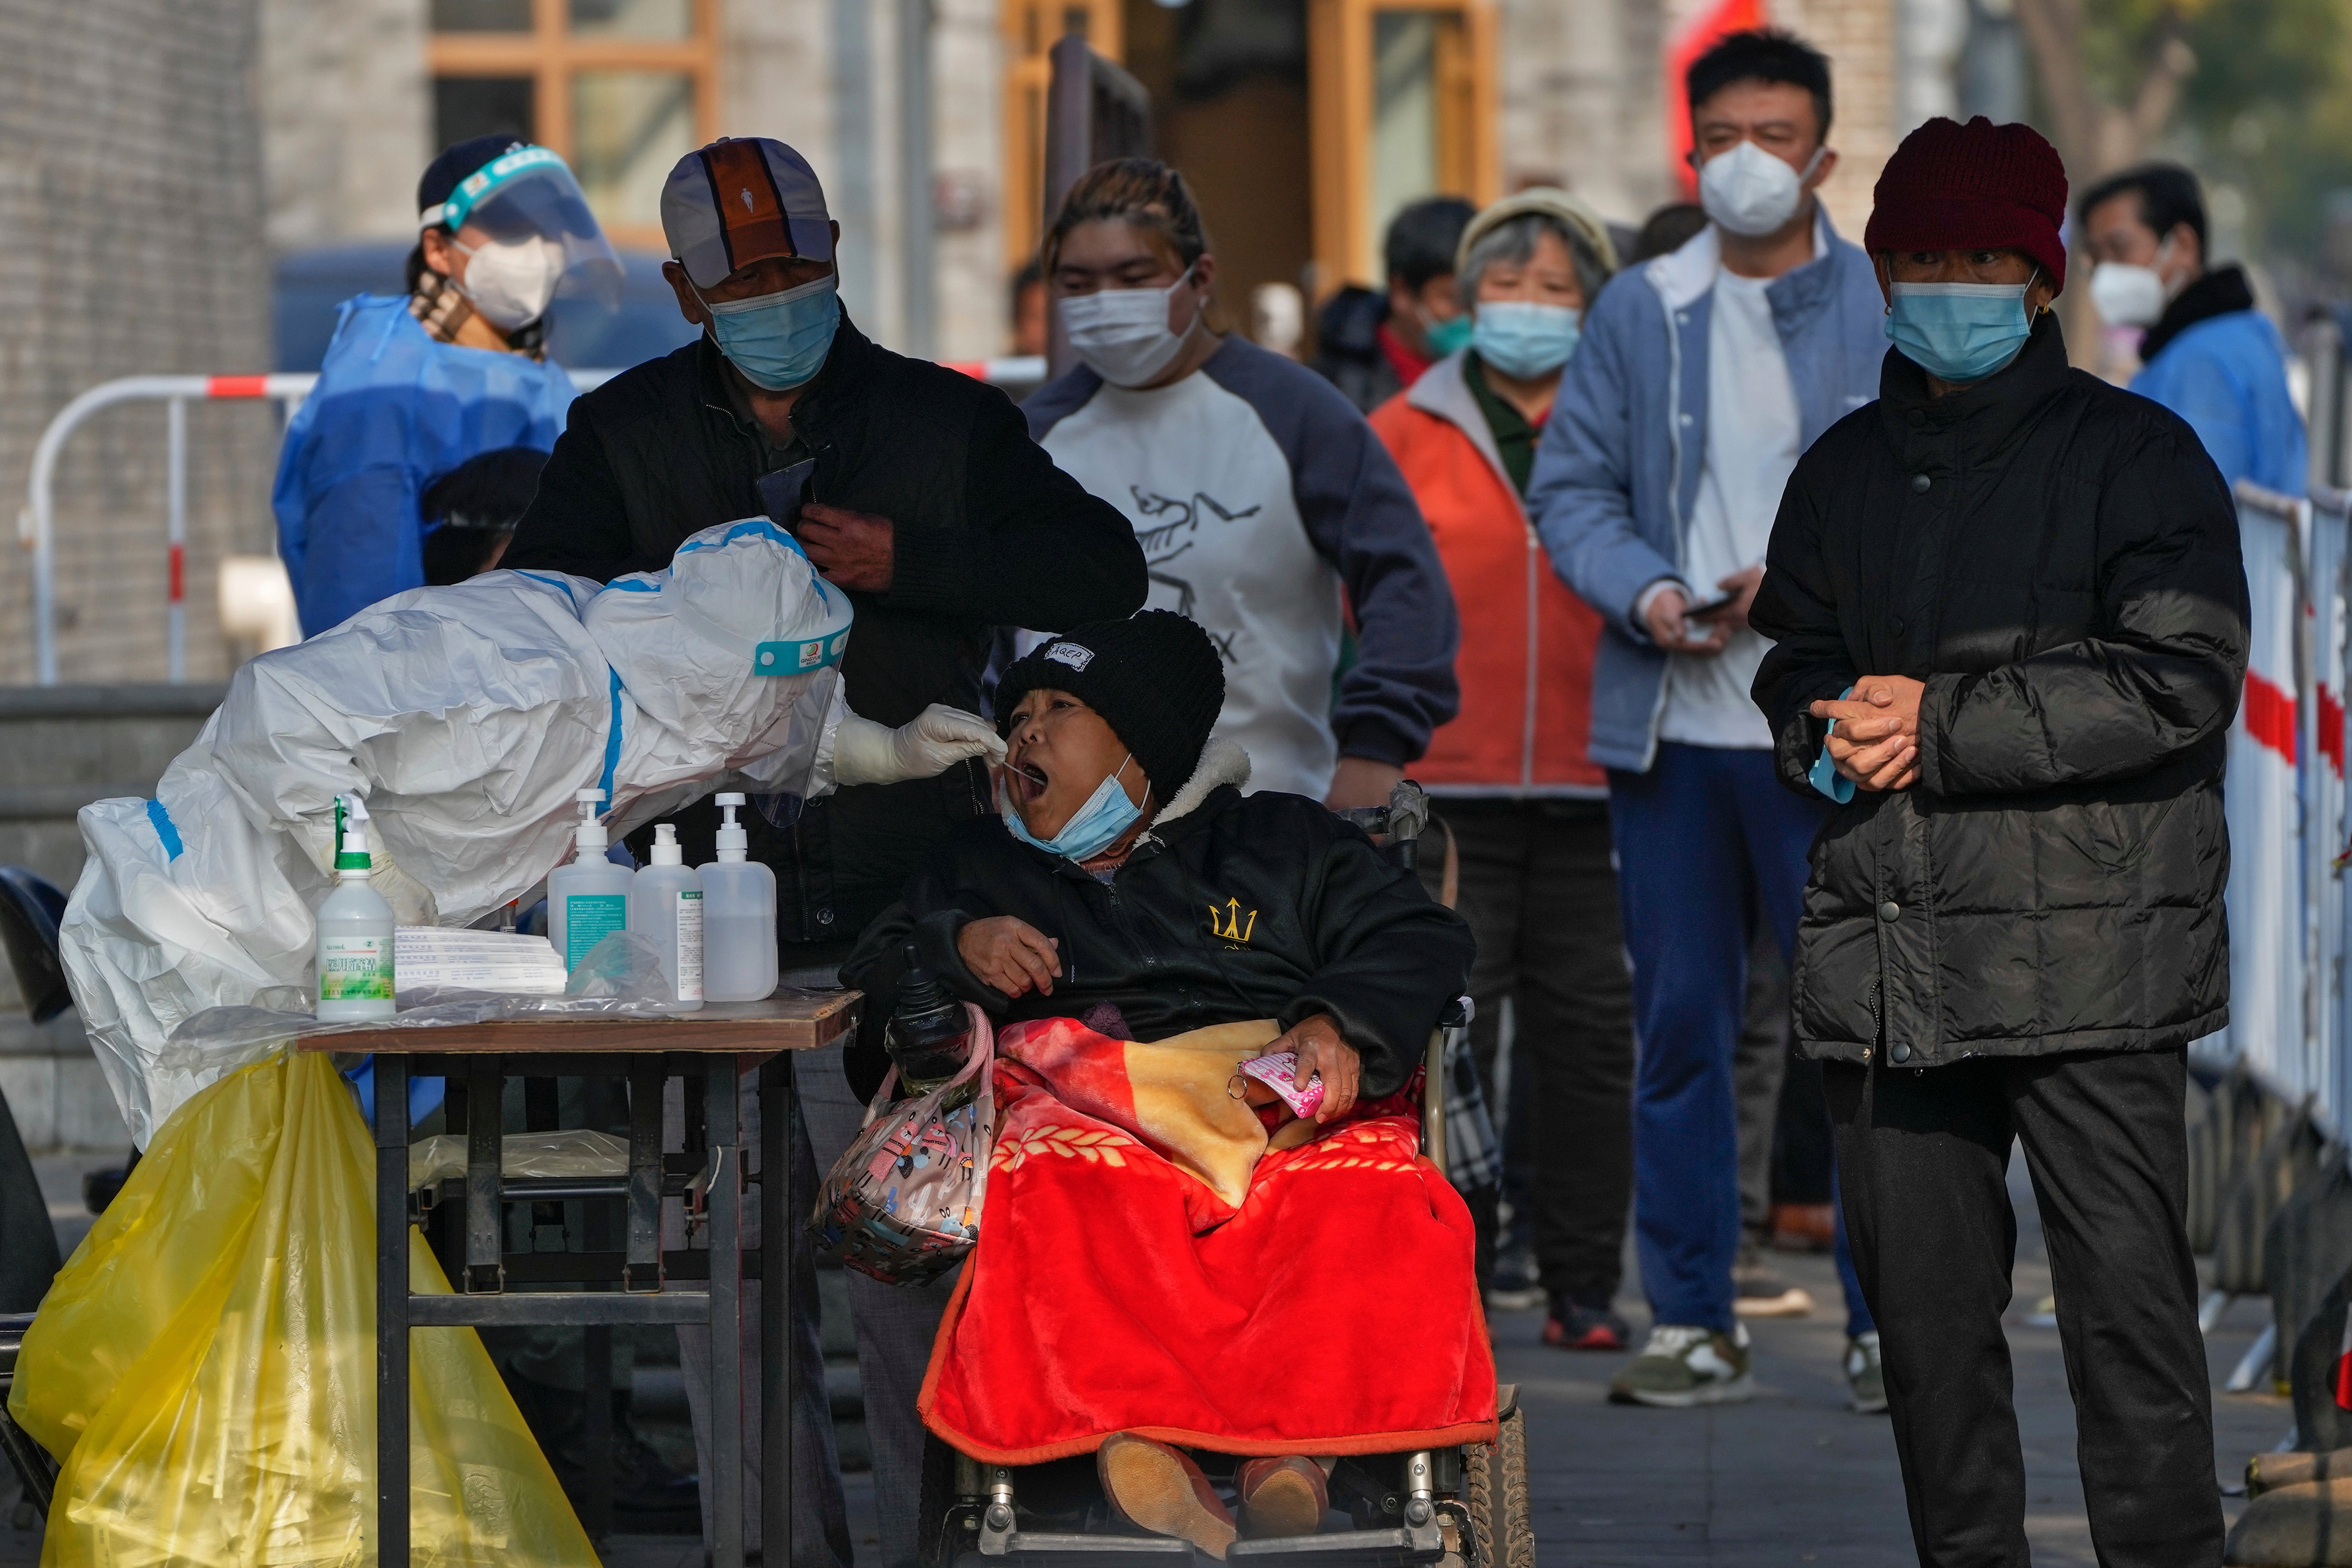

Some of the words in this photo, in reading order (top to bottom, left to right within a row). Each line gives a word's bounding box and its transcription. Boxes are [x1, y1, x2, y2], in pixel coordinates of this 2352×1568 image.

[800, 655, 821, 663] QINGYUE
[327, 958, 376, 971] 医用酒精
